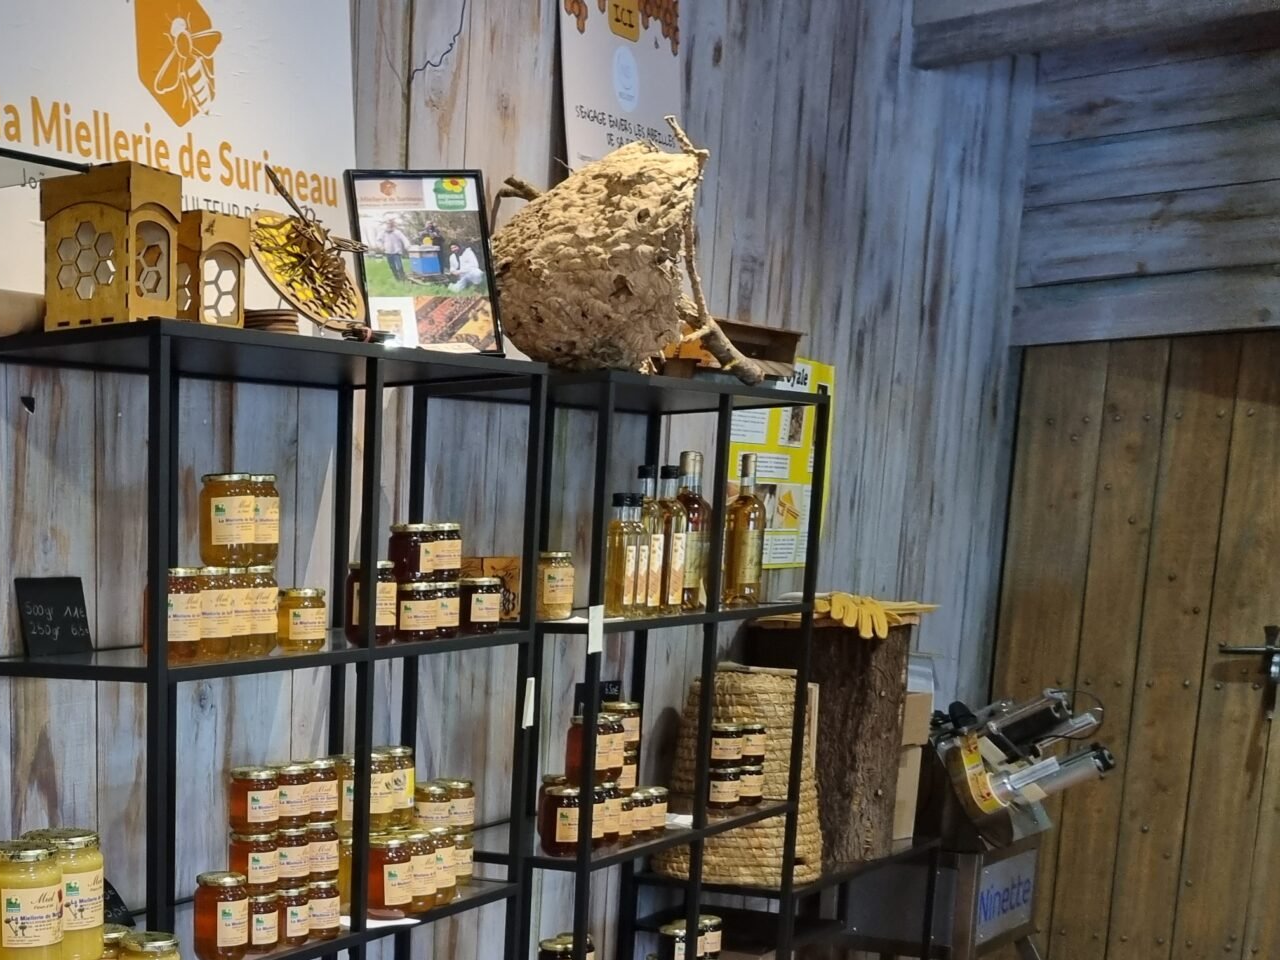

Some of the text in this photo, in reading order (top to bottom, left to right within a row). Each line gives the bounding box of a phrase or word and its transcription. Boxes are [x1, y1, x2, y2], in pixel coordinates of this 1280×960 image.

[31, 96, 170, 171] Miellerie
[179, 132, 212, 182] de
[219, 141, 339, 208] Surimeau
